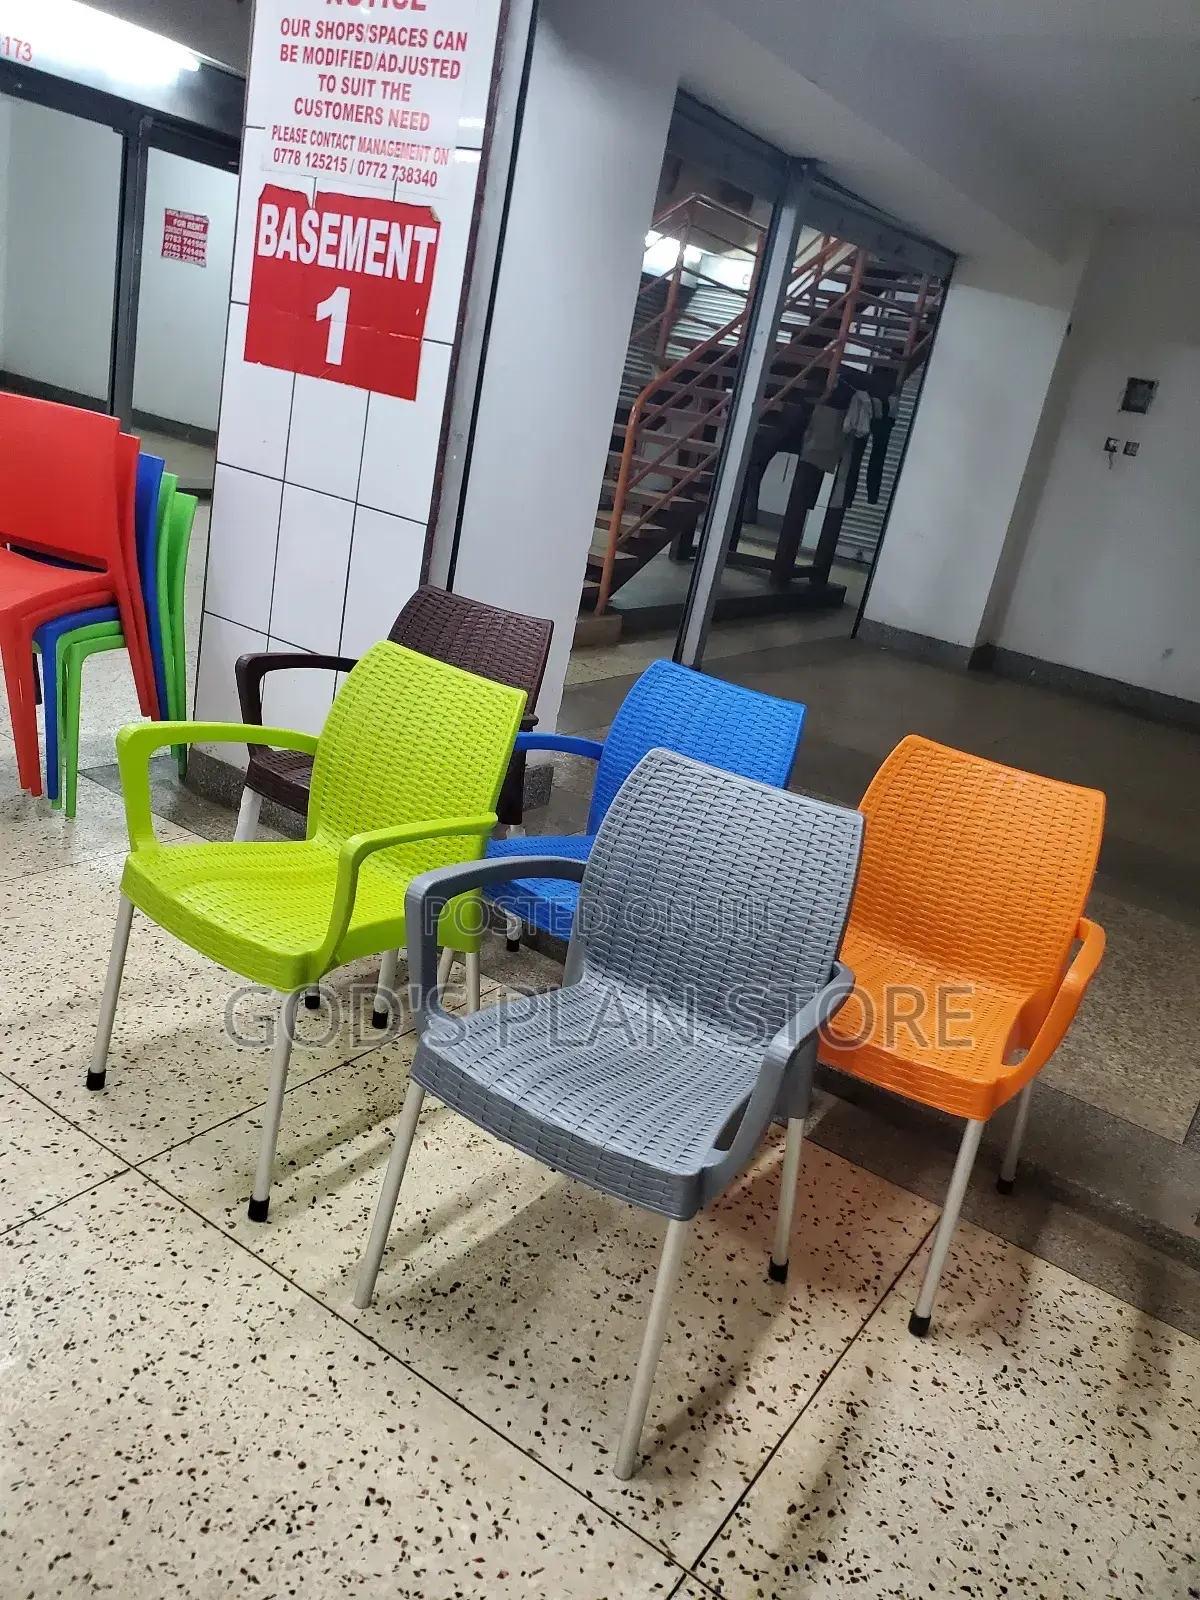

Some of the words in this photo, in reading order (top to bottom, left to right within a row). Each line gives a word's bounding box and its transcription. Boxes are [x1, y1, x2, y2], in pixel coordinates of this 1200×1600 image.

[280, 17, 311, 38] OUR
[315, 20, 428, 48] SHOPS/SPACES
[433, 29, 468, 52] CAN
[280, 43, 299, 63] BE
[302, 46, 461, 79] MODIFIED/ADJUSTED
[318, 74, 337, 93] TO
[341, 76, 377, 98] SUIT
[381, 80, 412, 102] THE
[294, 97, 384, 125] CUSTOMERS
[388, 108, 431, 132] NEED
[272, 125, 308, 145] PLEASE
[310, 129, 356, 151] CONTACT
[357, 136, 431, 163] MANAGEMENT
[433, 147, 450, 166] ON
[273, 147, 301, 166] 0778
[305, 151, 348, 173] 125215
[357, 159, 388, 179] 0772
[392, 164, 438, 188] 738340
[257, 203, 438, 284] BASEMENT
[315, 286, 351, 366] 1
